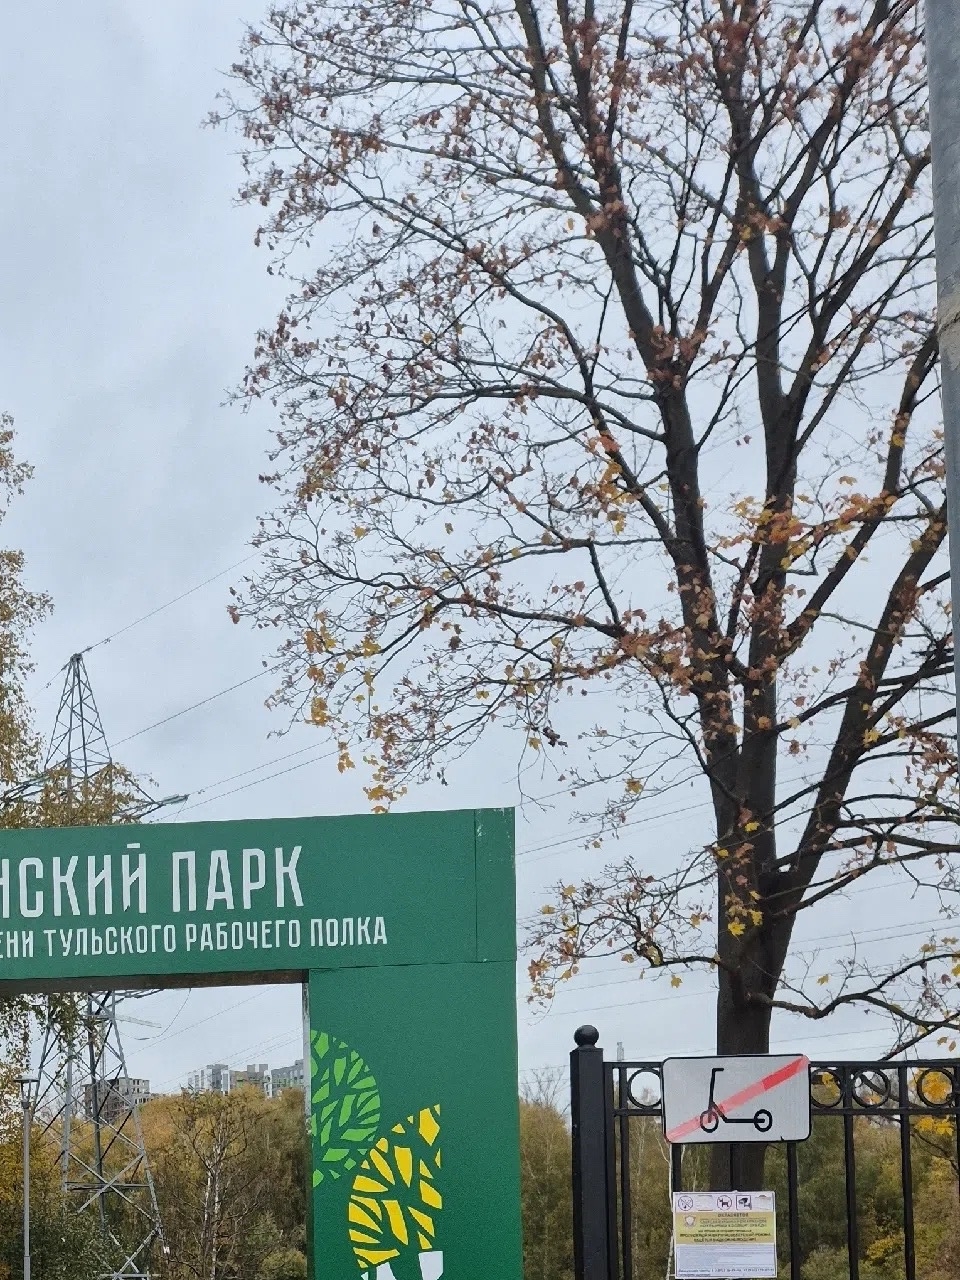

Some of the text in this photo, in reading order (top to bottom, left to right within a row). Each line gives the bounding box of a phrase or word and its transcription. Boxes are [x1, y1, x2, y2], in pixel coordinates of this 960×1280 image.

[172, 845, 304, 913] ПАРК
[43, 924, 176, 957] ТУЛЬСКОГО
[185, 919, 301, 952] РАБОЧЕГО
[310, 916, 388, 947] ПОЛКА
